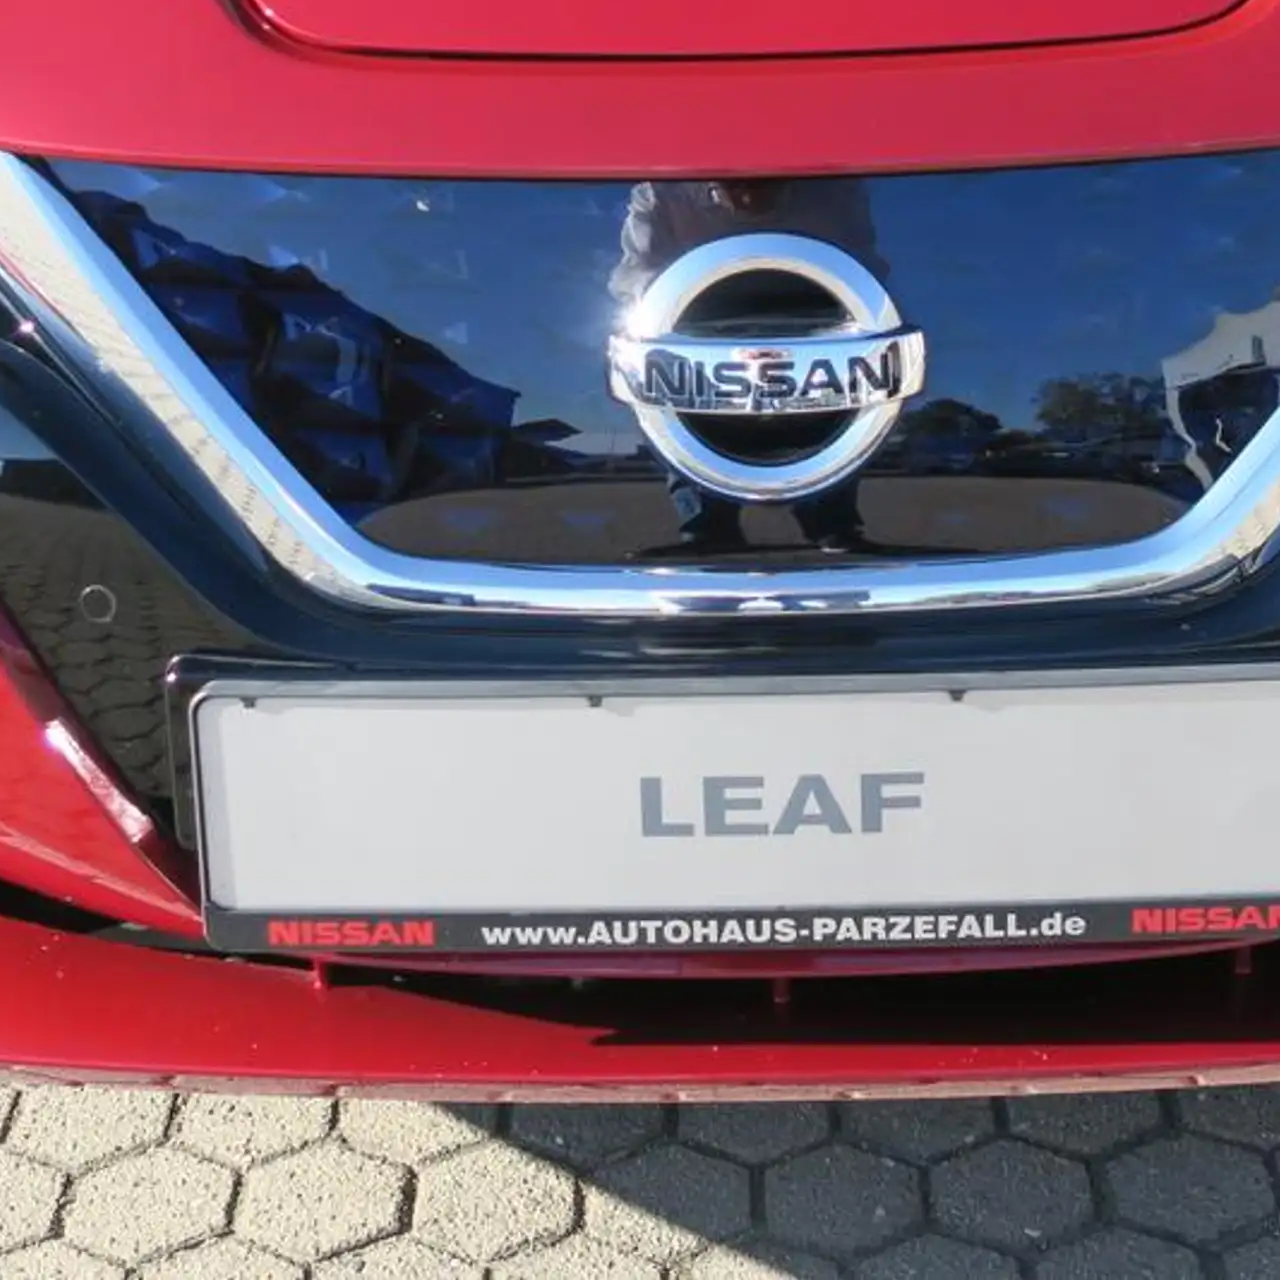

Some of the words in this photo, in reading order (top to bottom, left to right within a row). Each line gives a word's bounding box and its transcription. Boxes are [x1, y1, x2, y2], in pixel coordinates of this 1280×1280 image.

[644, 349, 898, 400] NISSAN
[641, 773, 926, 837] LEAF
[268, 920, 434, 946] NISSAN
[482, 913, 1086, 945] www.AUTOHAUS-PARZEFALL.de
